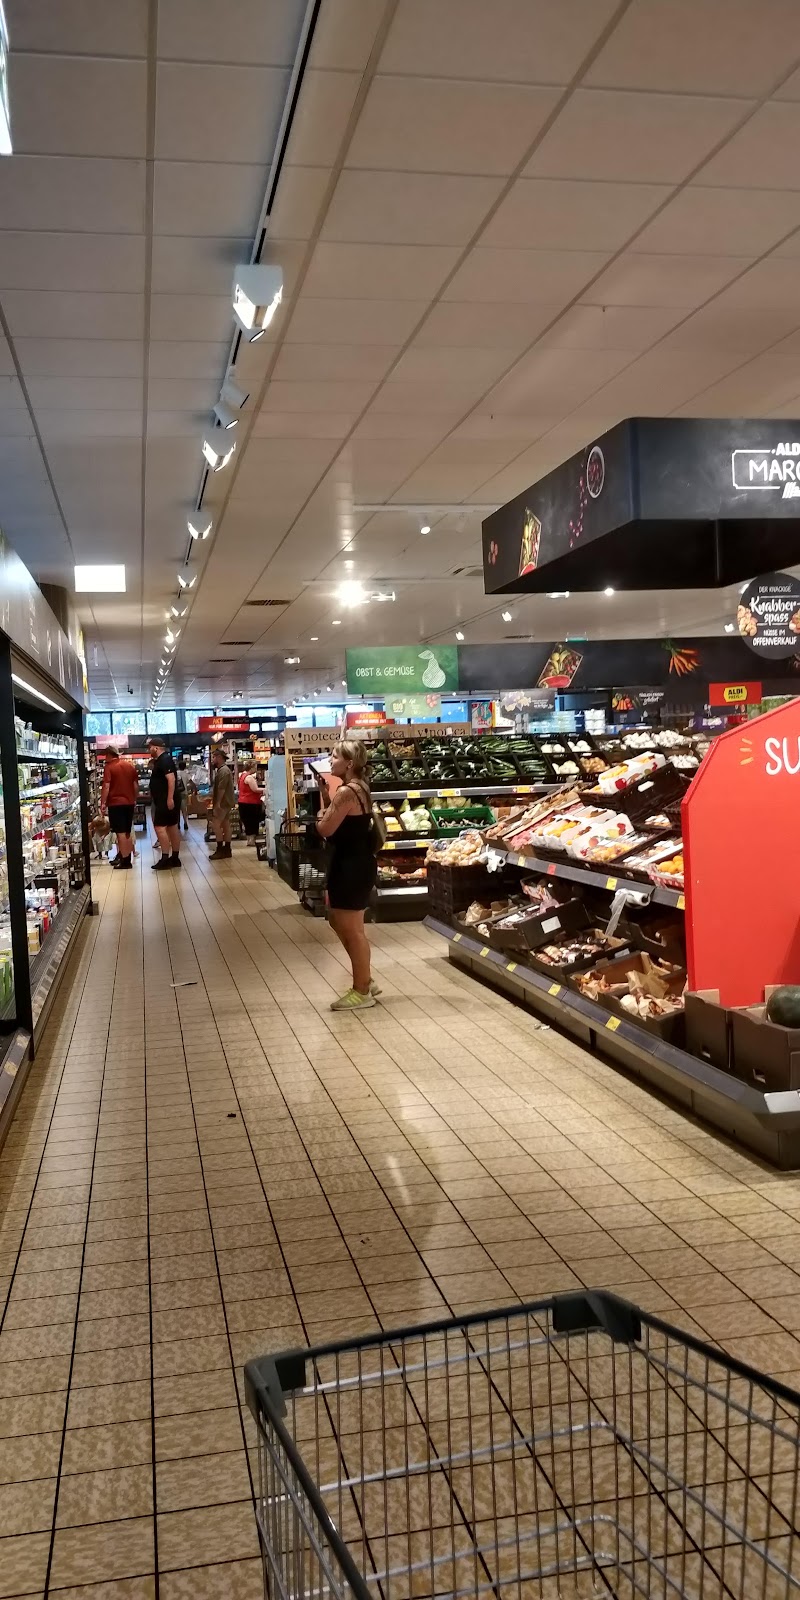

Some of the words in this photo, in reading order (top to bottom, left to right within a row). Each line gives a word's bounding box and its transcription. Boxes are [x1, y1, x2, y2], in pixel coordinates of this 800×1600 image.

[764, 612, 789, 626] spass
[355, 667, 374, 677] OBST
[376, 667, 383, 677] &
[383, 665, 415, 677] GEMÜSE
